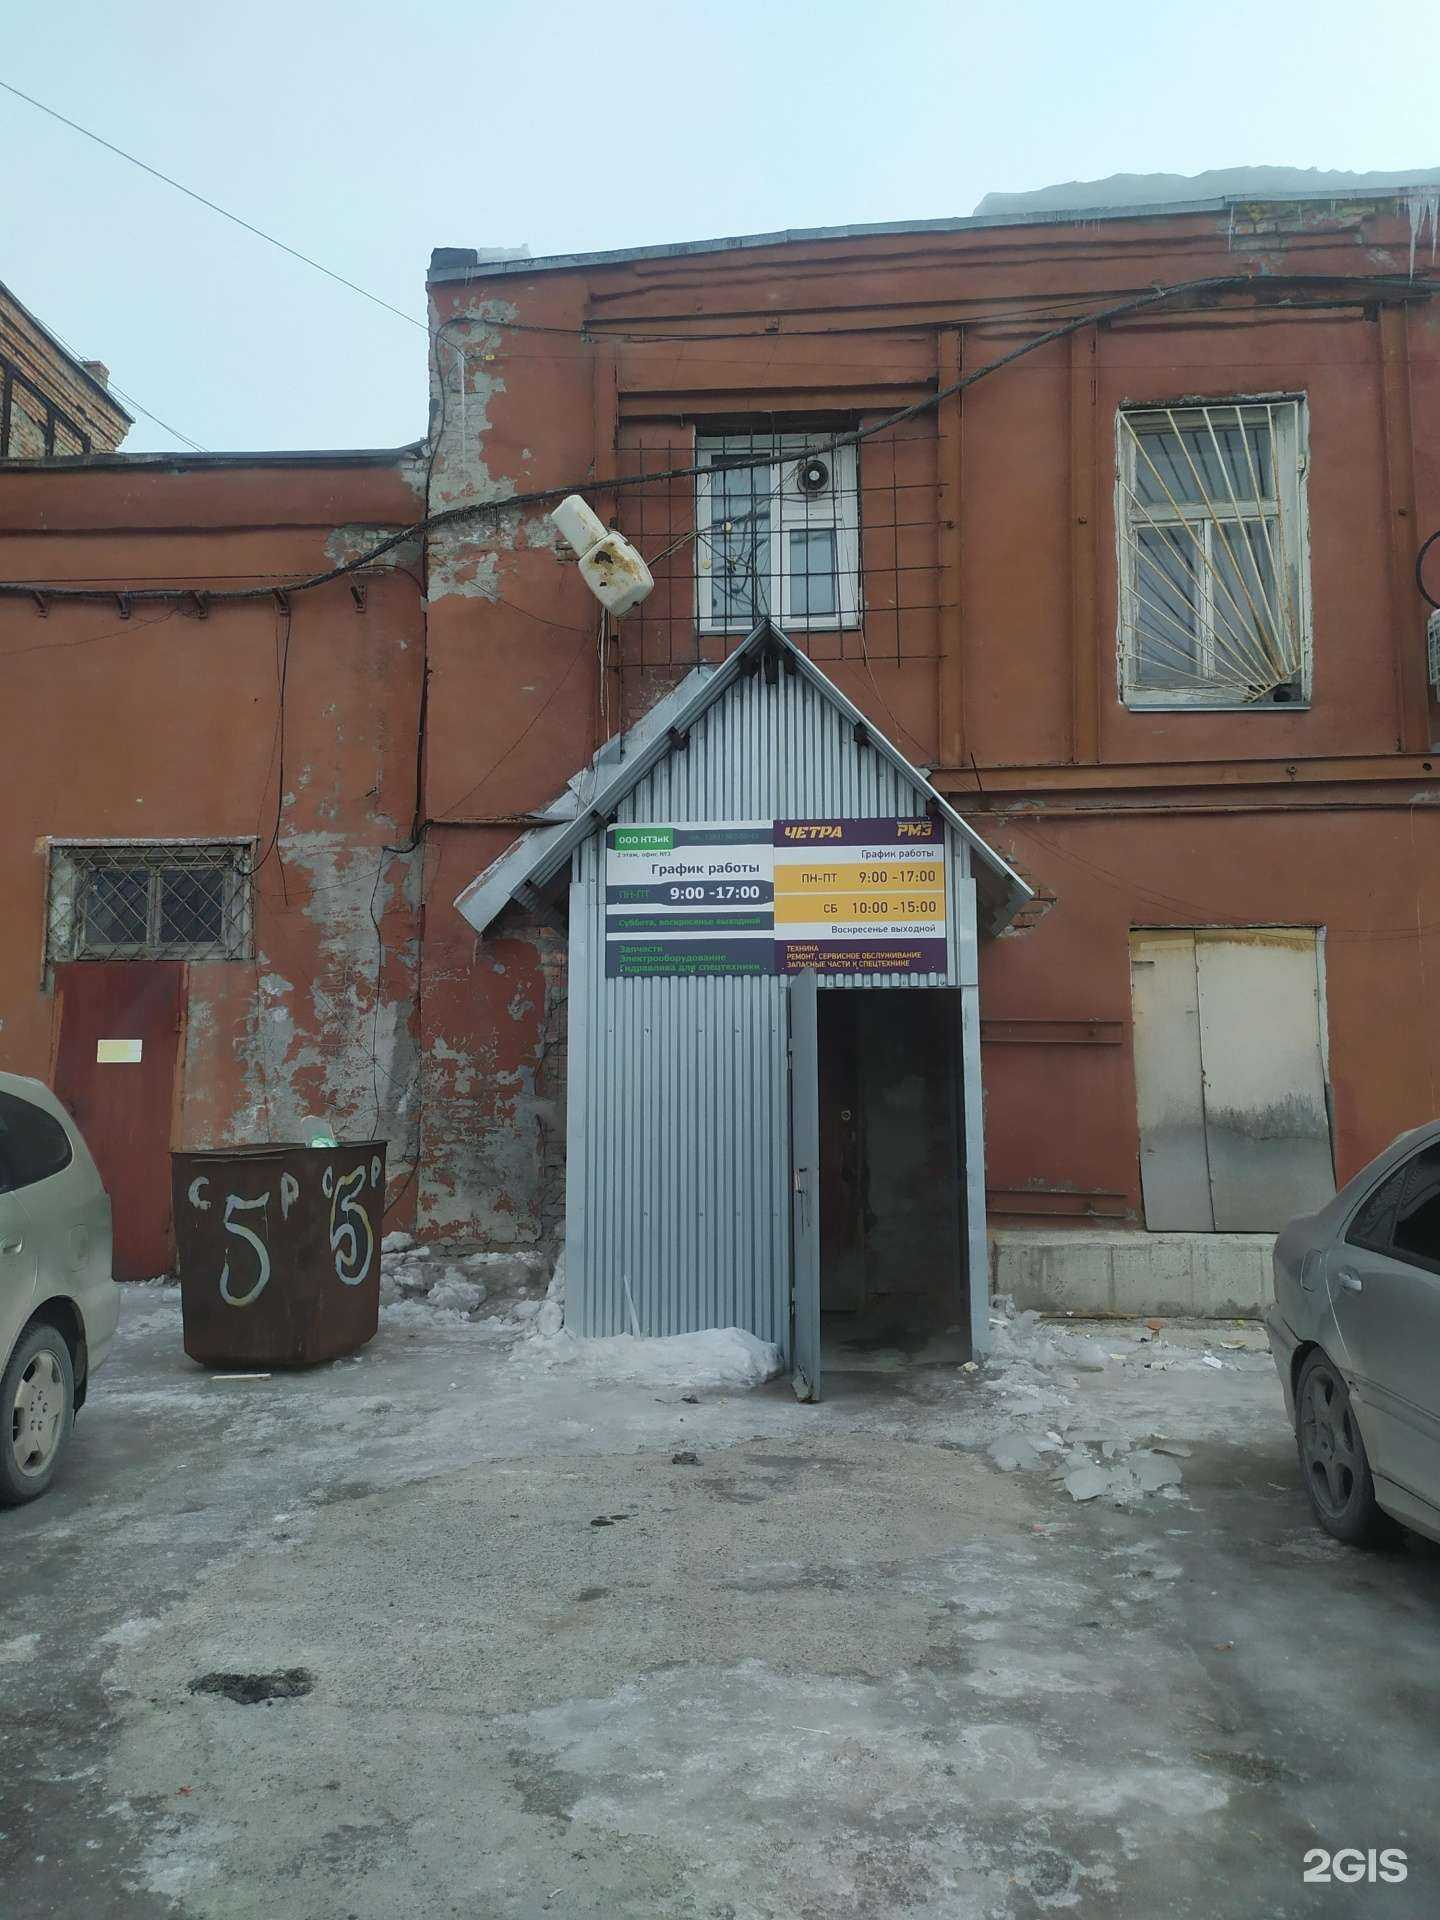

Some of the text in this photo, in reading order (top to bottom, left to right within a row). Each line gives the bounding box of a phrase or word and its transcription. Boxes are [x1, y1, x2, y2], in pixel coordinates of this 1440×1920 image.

[785, 826, 843, 839] ЧЕТРА
[896, 822, 933, 837] РМЗ
[619, 836, 639, 844] ООО
[861, 848, 935, 860] График работы
[651, 861, 760, 877] График работы
[802, 872, 838, 883] ПН-ПТ
[859, 871, 888, 884] 9:00
[670, 885, 705, 900] 9:00
[823, 903, 838, 913] СБ
[852, 901, 888, 914] 10:00
[831, 923, 936, 935] Воскресенье выходной
[786, 944, 820, 952] ТЕХНИКА
[786, 951, 922, 961] РЕМОНТ, СЕРВИСНОЕ ОБСЛУЖИВАНИЕ
[786, 959, 910, 969] ЗАПАСНЫЕ ЧАСТИ К СПЕЦТЕХНИКЕ
